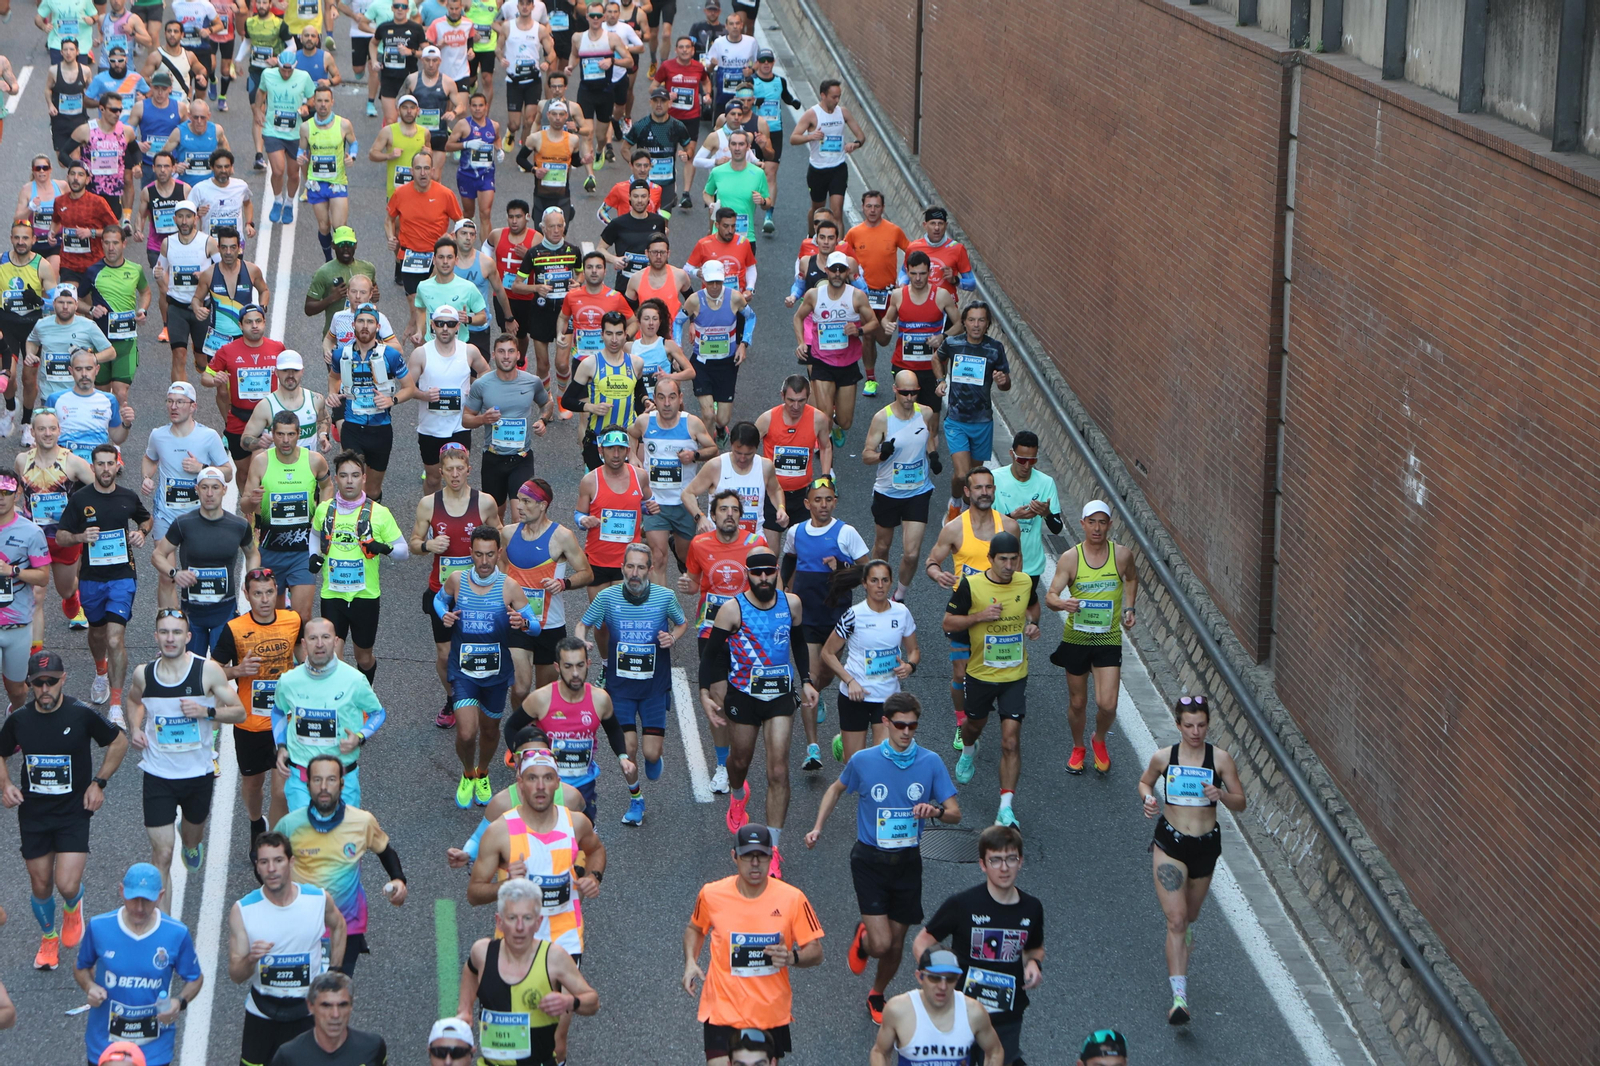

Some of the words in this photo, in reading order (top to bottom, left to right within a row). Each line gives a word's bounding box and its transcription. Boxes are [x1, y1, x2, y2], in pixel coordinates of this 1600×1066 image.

[1076, 581, 1116, 590] CHIANCHIA
[986, 623, 1023, 633] CORTES
[257, 642, 288, 654] GALBIS
[545, 876, 569, 884] ZURICH
[118, 977, 162, 989] BETANO
[986, 975, 1010, 985] ZURICH
[126, 1007, 153, 1017] ZURICH
